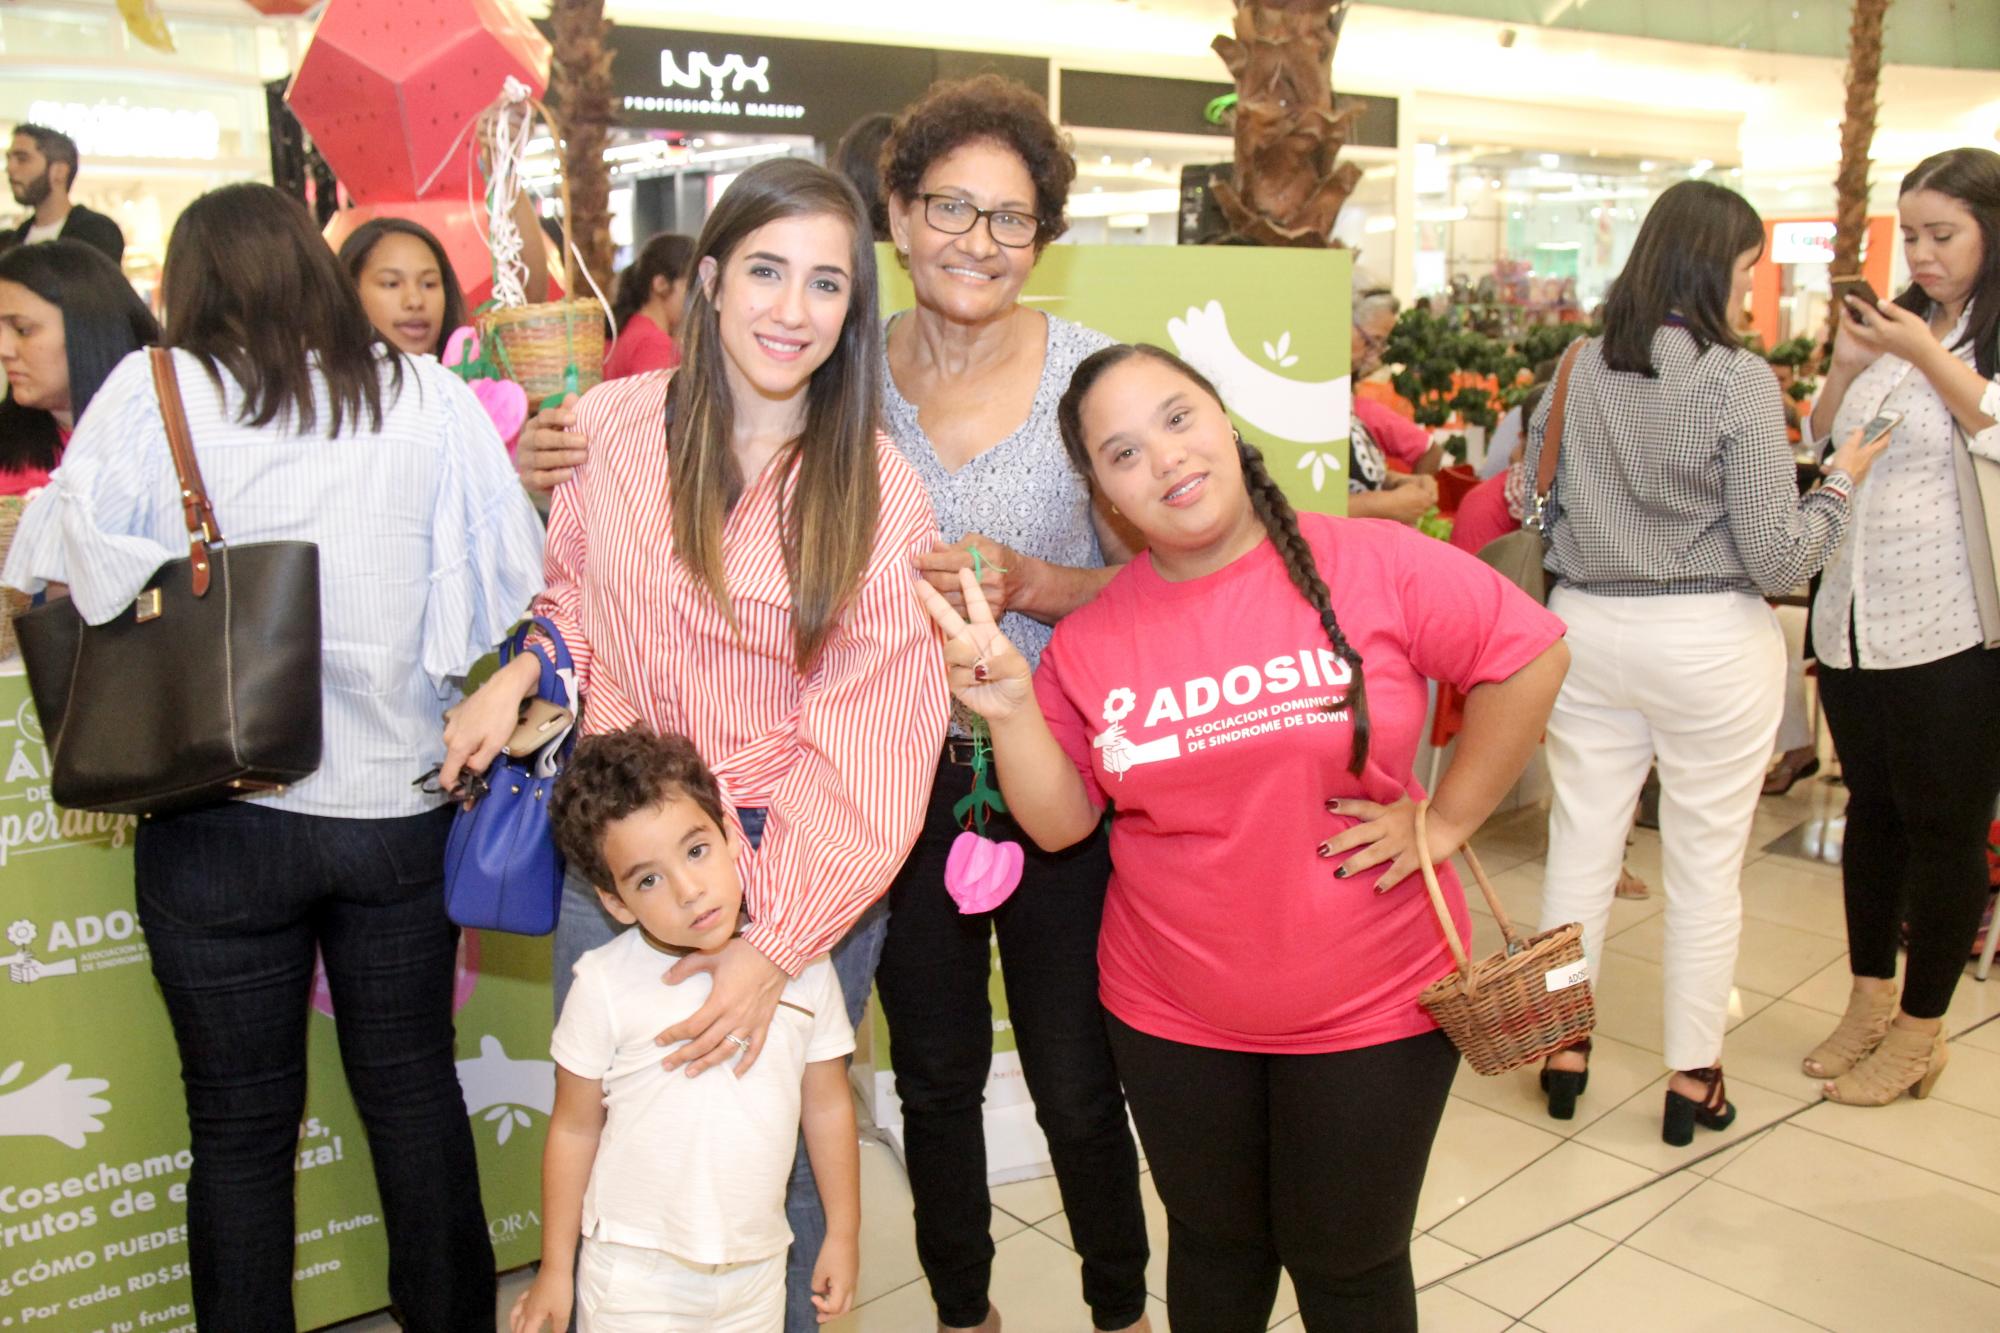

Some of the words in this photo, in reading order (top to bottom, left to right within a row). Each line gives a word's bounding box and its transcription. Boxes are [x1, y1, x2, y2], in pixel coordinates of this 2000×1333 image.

[661, 49, 770, 101] NYX
[624, 96, 740, 116] PROFESSIONAL
[745, 102, 806, 119] MAKEUP
[1185, 708, 1268, 739] ASOCIACION
[1271, 695, 1347, 715] DOMINICA
[1187, 740, 1206, 753] DE
[1208, 719, 1282, 748] SINDROME
[1284, 714, 1304, 729] DE
[1306, 710, 1349, 725] DOWN
[48, 910, 144, 952] ADO
[0, 1206, 97, 1248] rutos
[110, 1190, 156, 1218] de
[21, 1303, 62, 1323] Por
[68, 1284, 121, 1309] cada
[328, 1213, 380, 1236] fruta.
[139, 1303, 191, 1327] fruta
